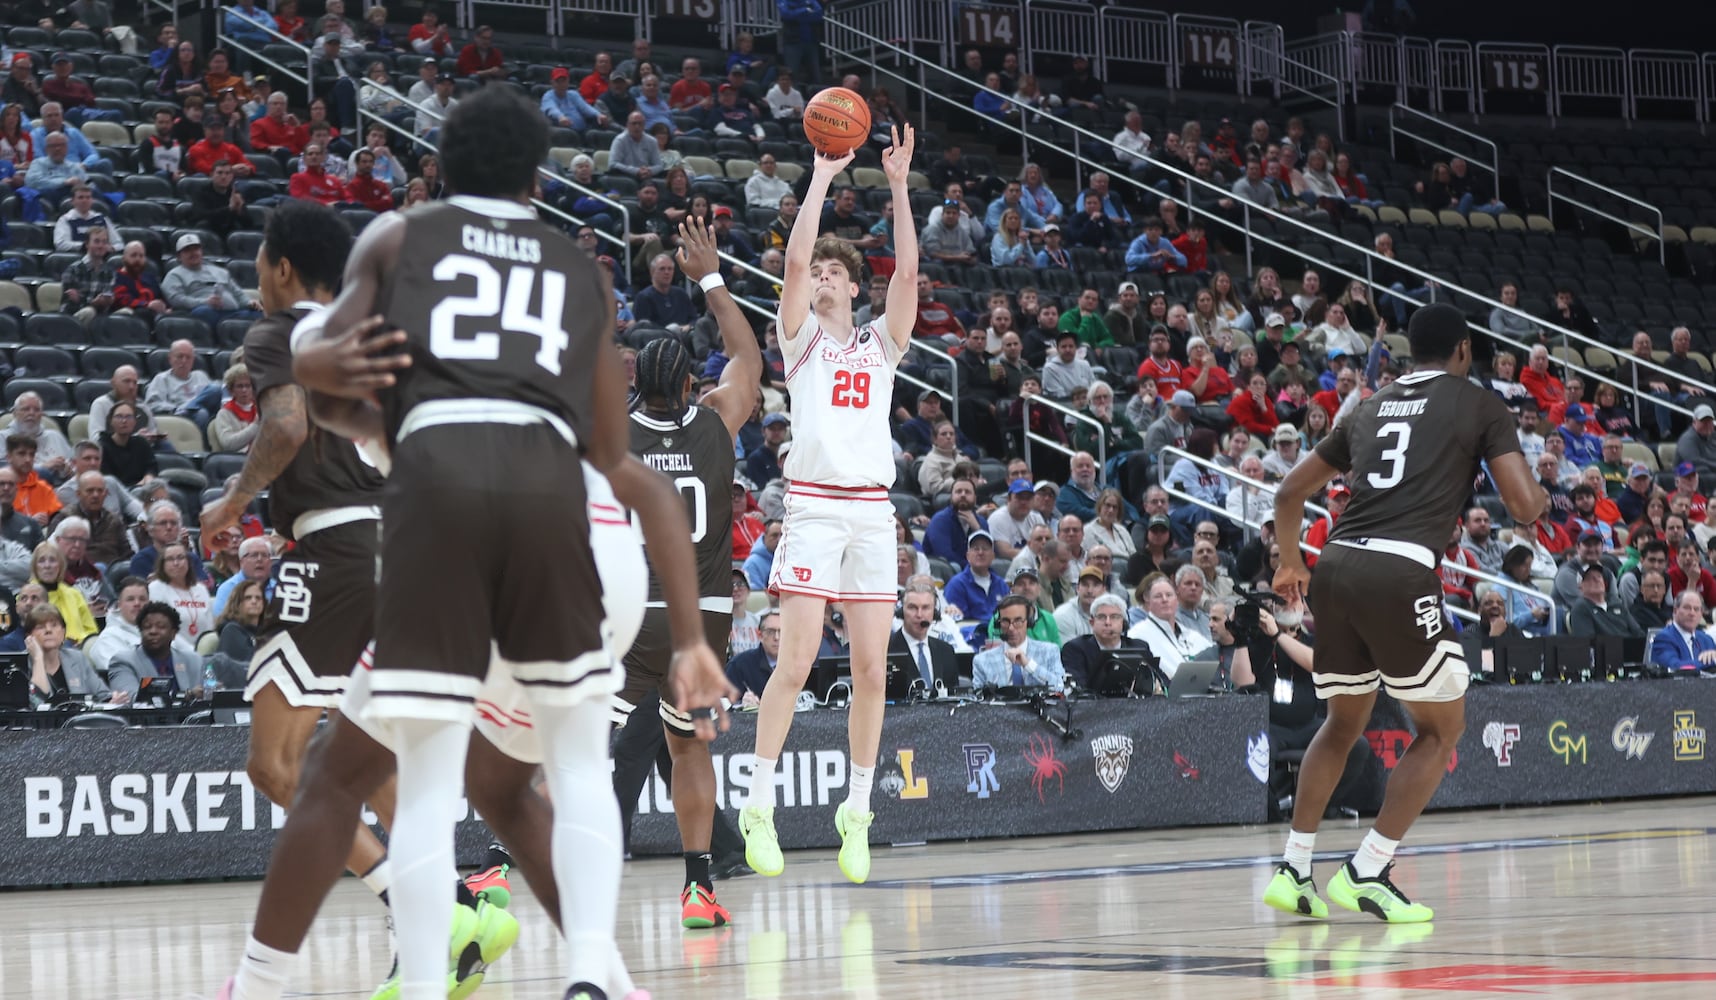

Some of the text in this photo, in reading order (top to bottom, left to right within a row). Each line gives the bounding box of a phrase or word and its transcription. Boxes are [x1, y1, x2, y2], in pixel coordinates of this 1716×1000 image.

[965, 11, 1013, 45] 114
[1189, 34, 1232, 65] 114
[1493, 60, 1539, 90] 115
[462, 224, 541, 264] CHARLES
[429, 253, 569, 377] 24
[831, 370, 871, 409] 29
[642, 453, 693, 472] MITCHELL
[1367, 421, 1412, 489] 3
[1090, 733, 1134, 758] BONNIES
